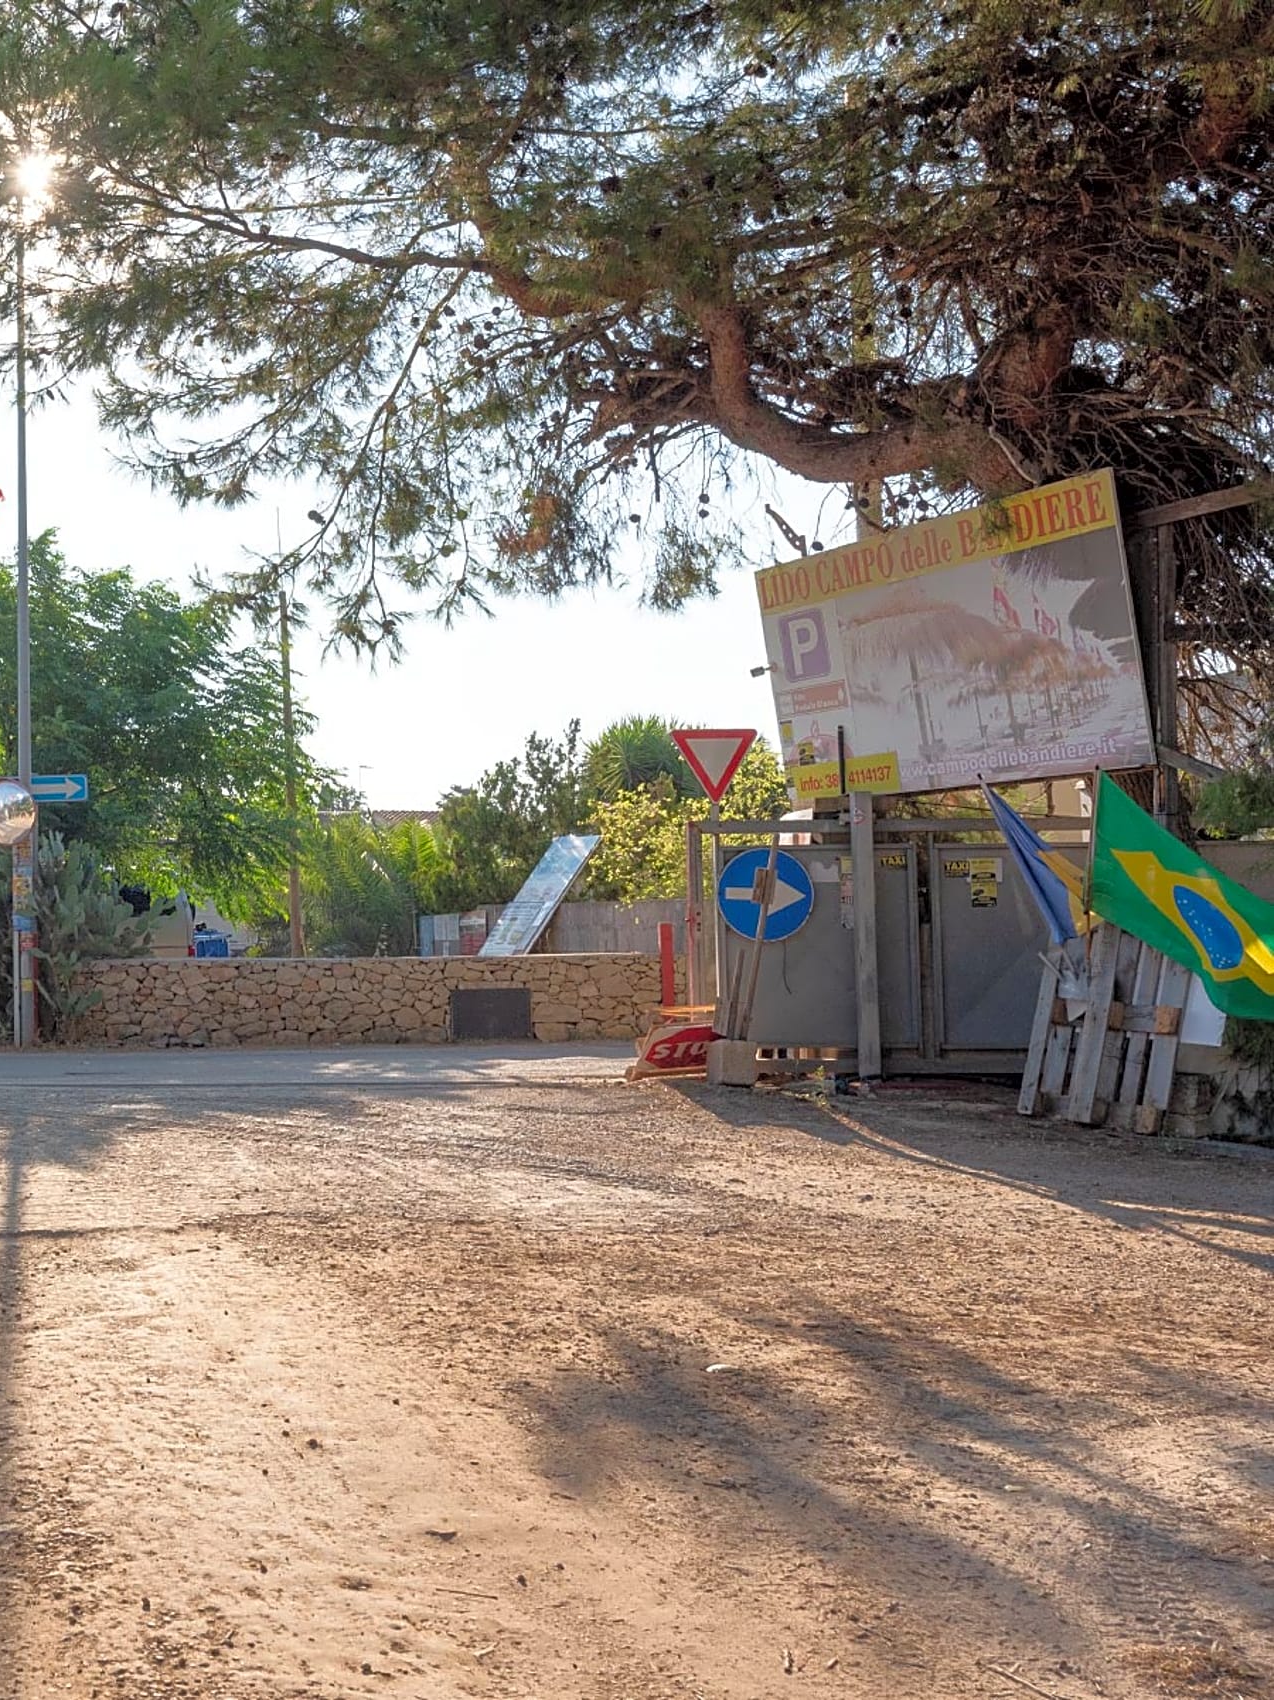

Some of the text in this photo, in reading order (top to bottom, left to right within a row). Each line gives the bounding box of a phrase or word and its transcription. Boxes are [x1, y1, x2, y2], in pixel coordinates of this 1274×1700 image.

[759, 481, 1107, 610] LIDO CAMPO delle BDIERE
[788, 618, 819, 676] P
[881, 855, 906, 867] TAXI
[944, 860, 969, 871] TAXI
[652, 1040, 708, 1060] STO
